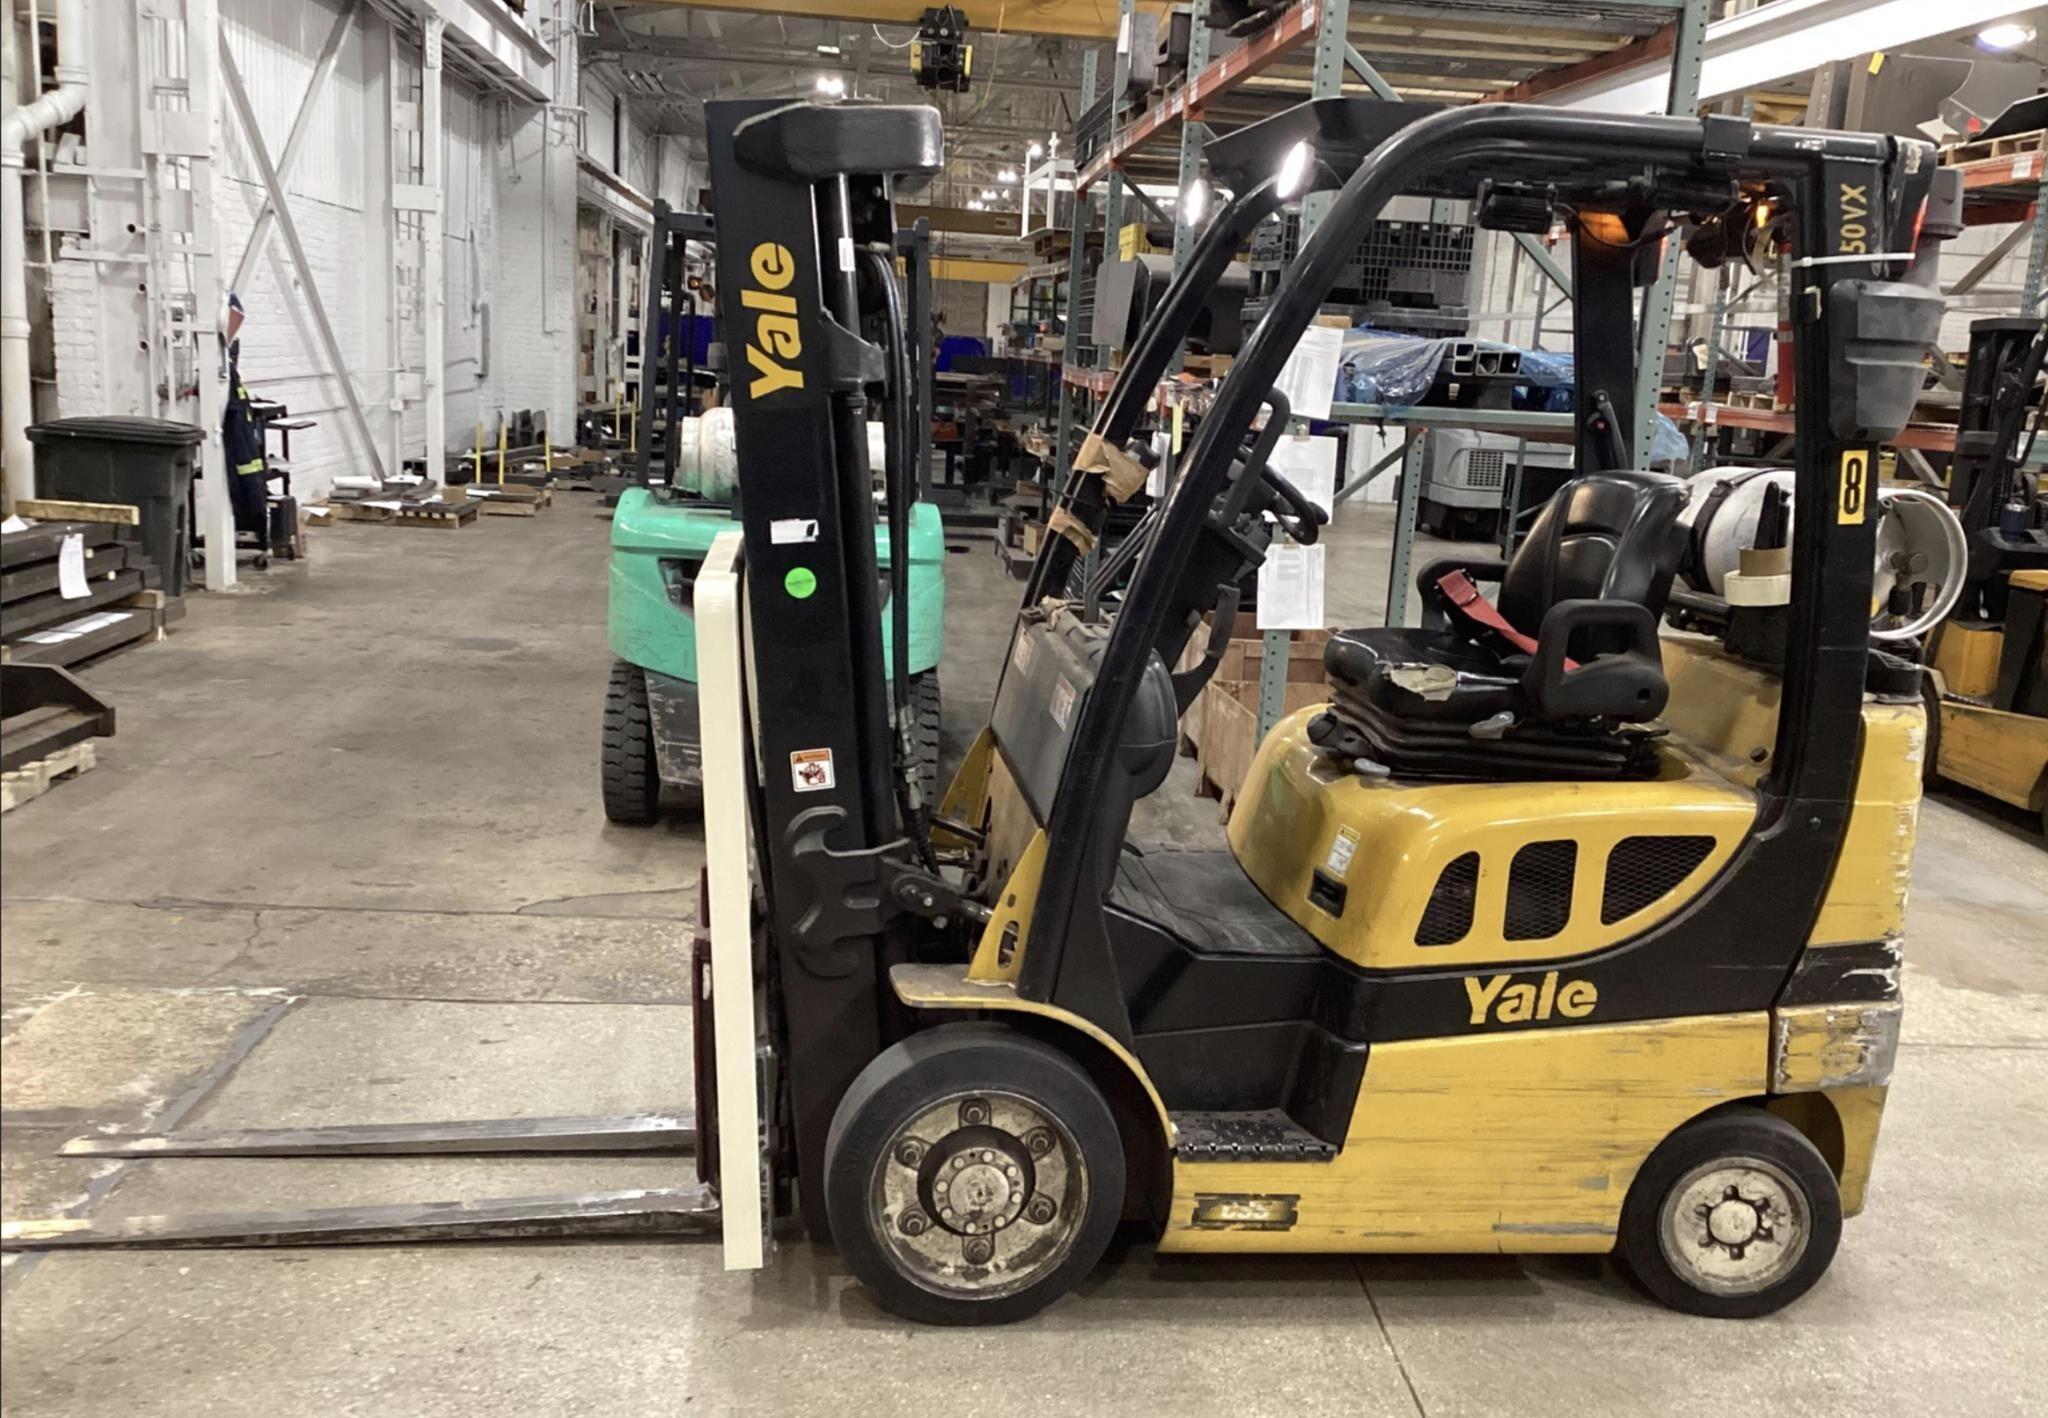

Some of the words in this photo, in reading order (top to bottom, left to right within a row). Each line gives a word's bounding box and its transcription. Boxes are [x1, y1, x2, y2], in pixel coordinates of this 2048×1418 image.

[741, 242, 804, 400] Yale
[1844, 458, 1862, 515] 8
[1464, 971, 1598, 1025] Yale
